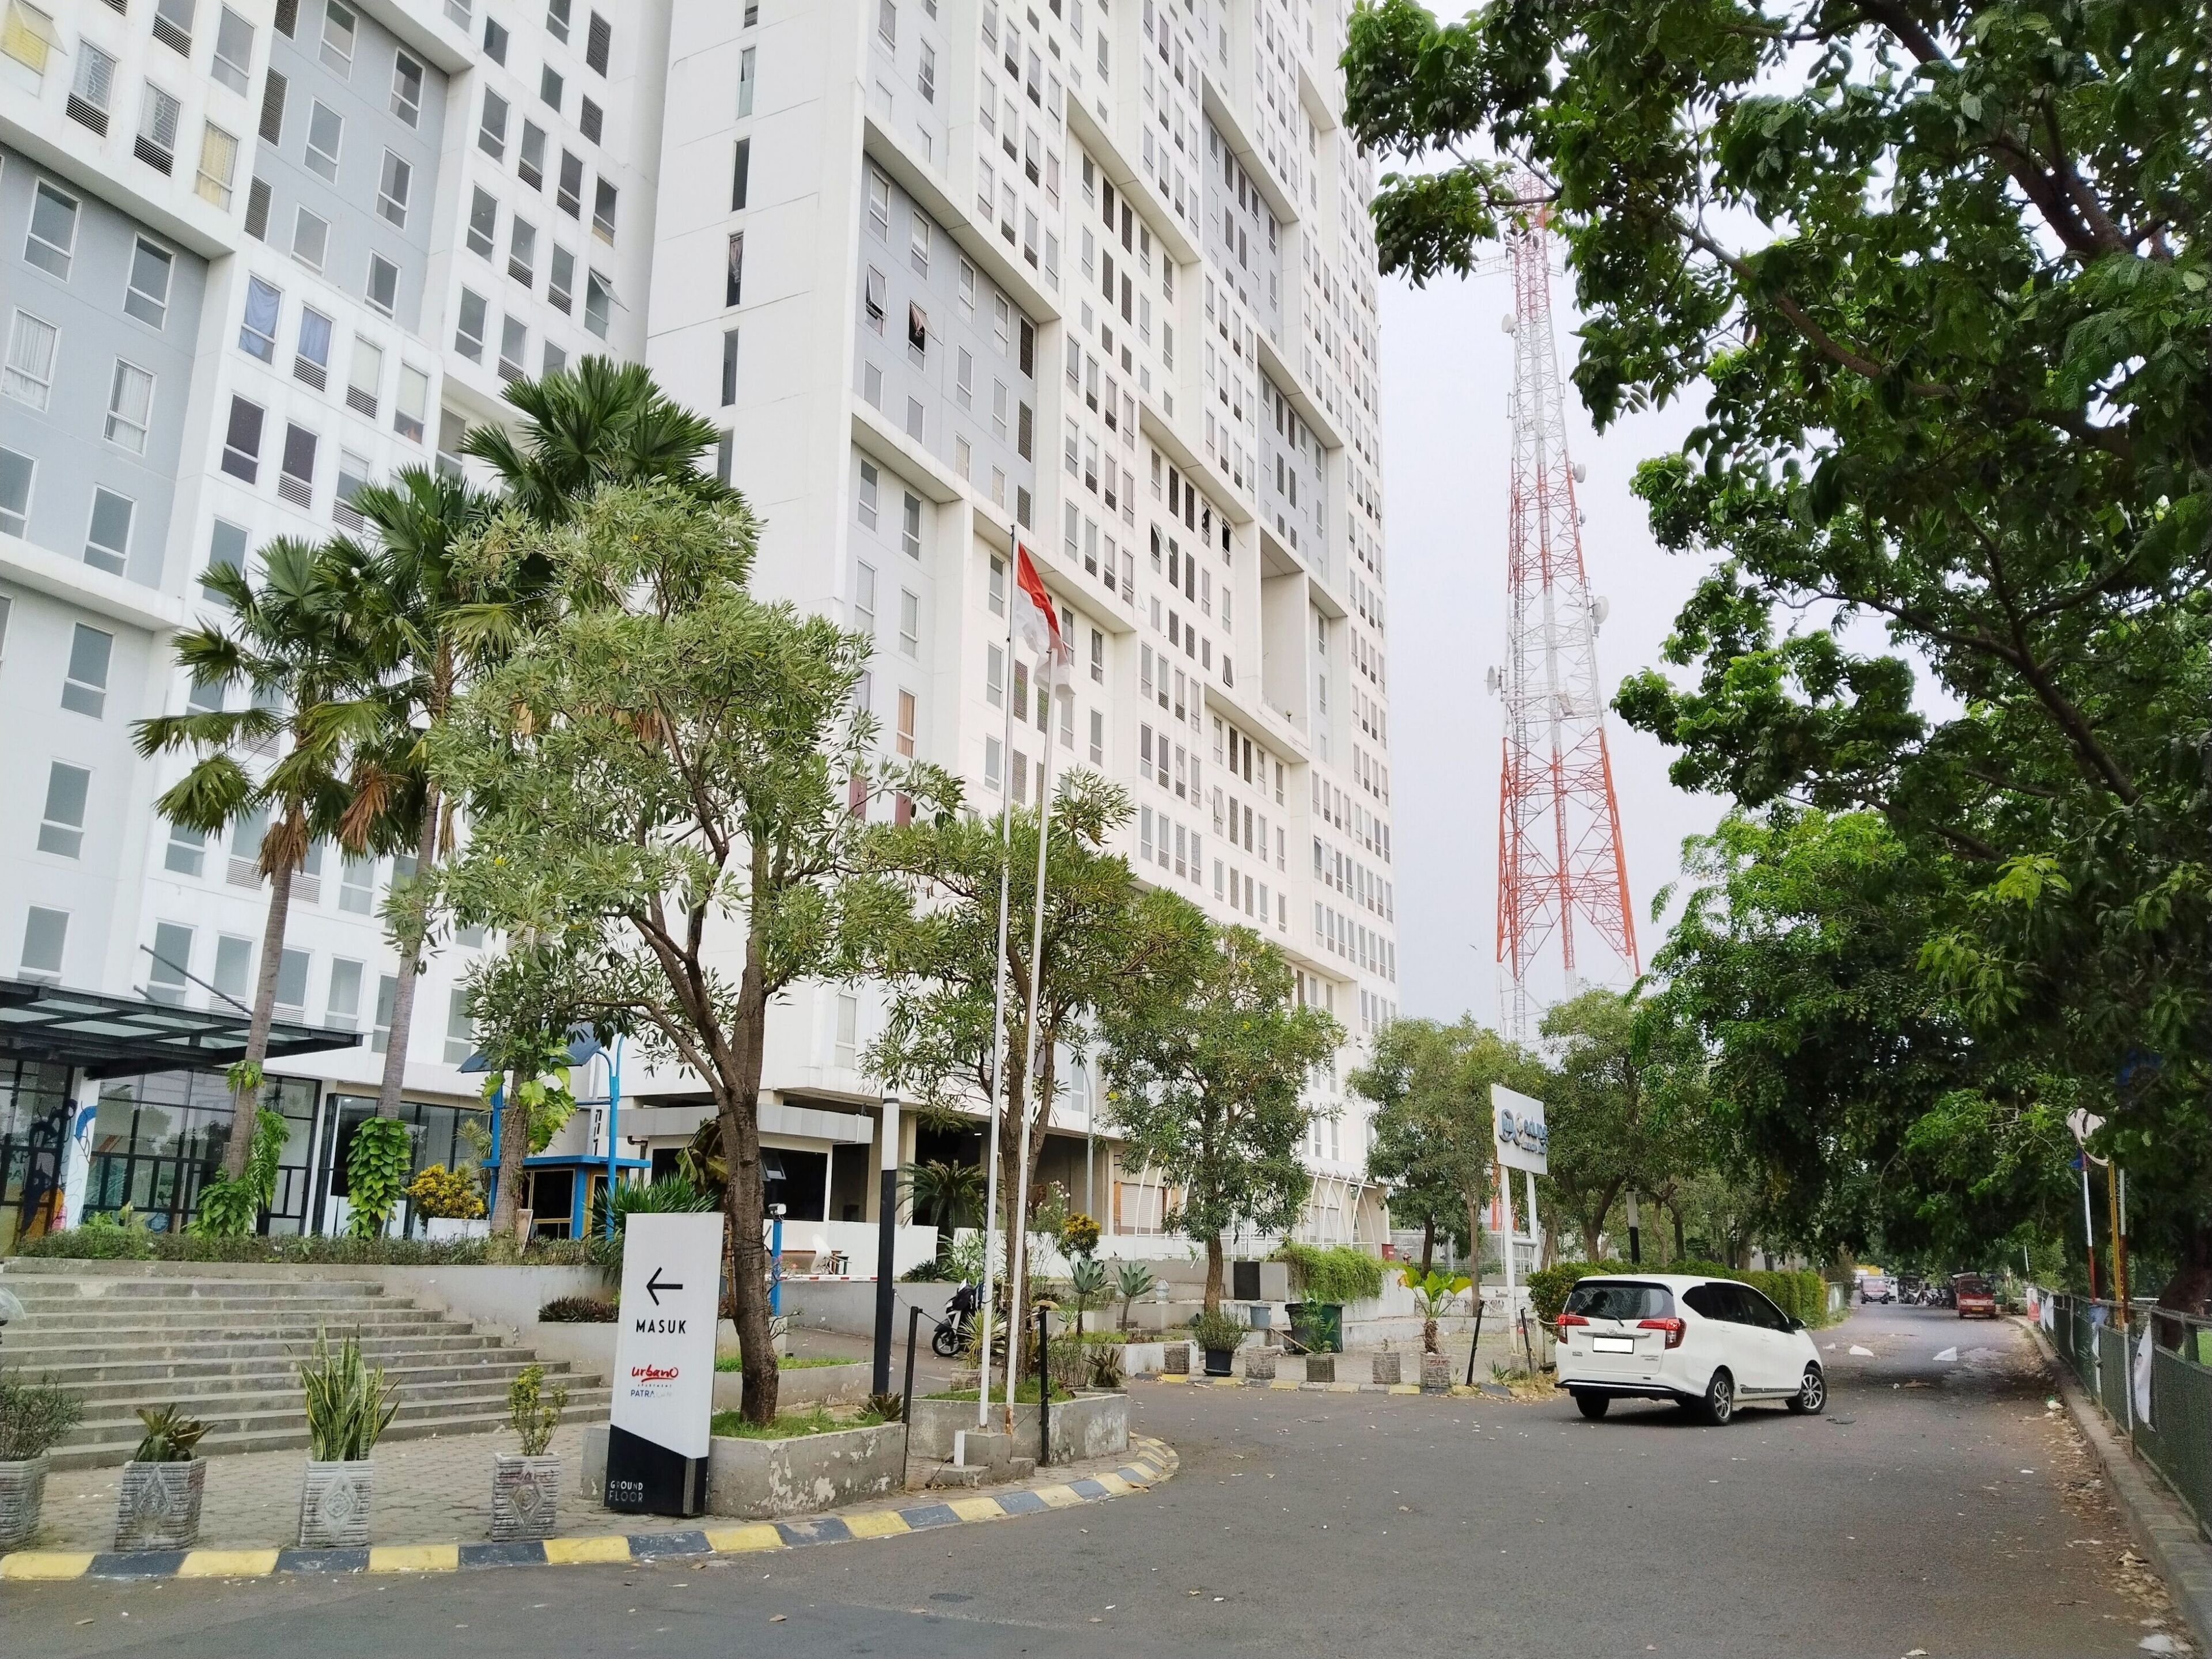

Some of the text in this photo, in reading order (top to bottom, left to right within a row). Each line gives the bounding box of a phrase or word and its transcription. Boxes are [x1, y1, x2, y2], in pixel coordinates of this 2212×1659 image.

[635, 1318, 687, 1335] MASUK
[610, 1480, 644, 1491] GROUND
[608, 1490, 644, 1503] FLOOR
